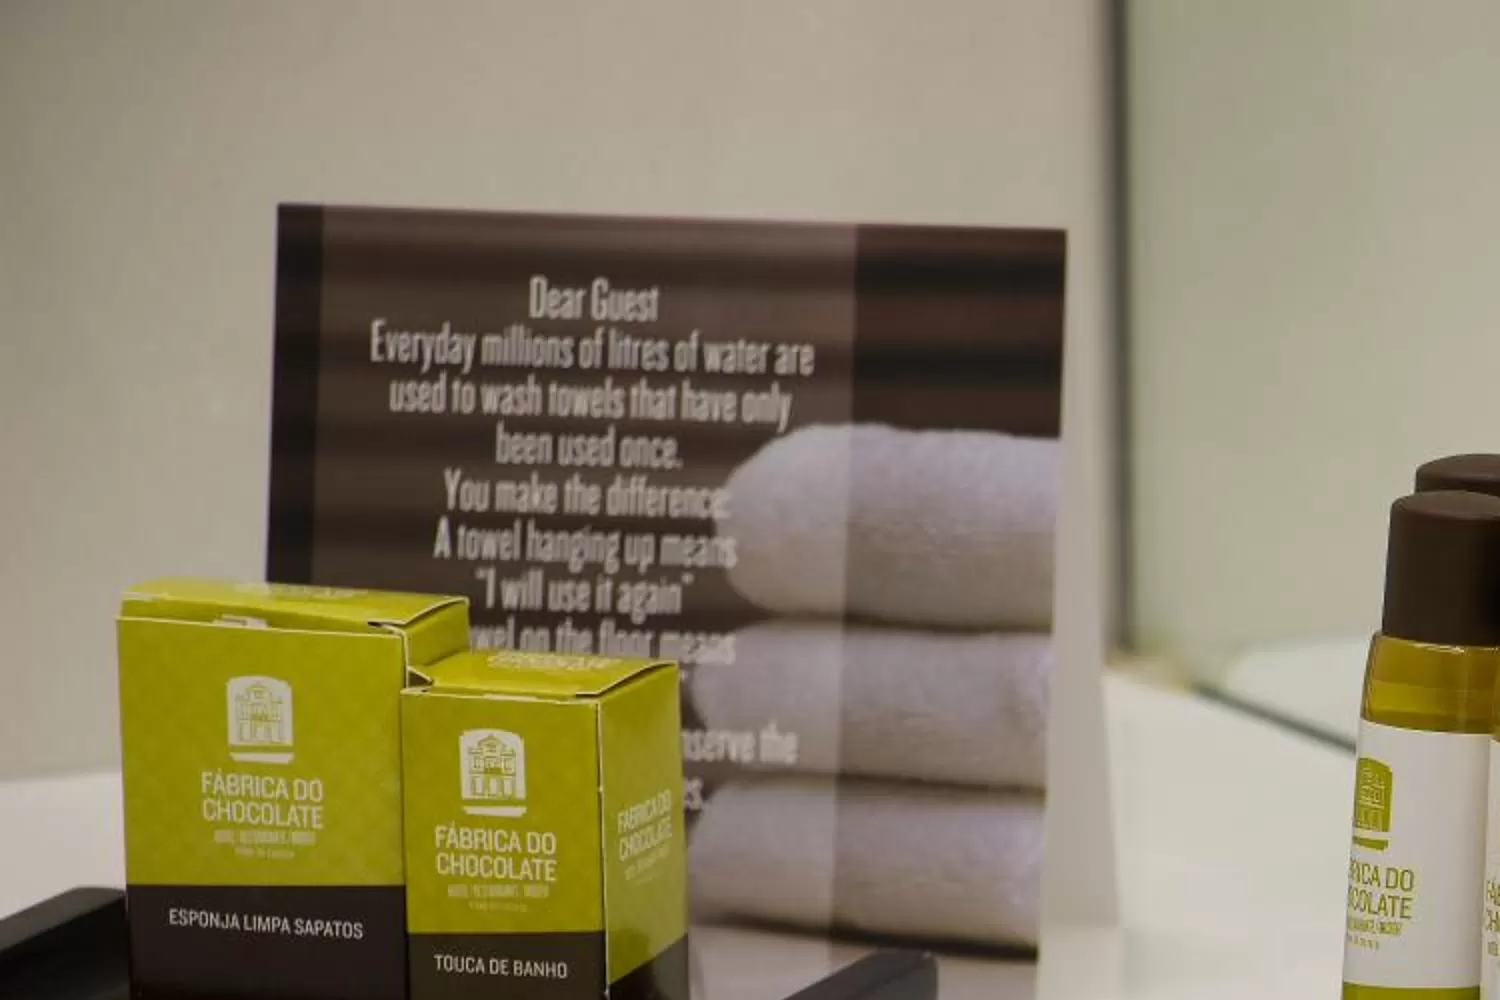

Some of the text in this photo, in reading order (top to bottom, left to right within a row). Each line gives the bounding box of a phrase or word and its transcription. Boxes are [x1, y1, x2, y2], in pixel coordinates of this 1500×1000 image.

[529, 273, 659, 323] Dear Guest
[370, 317, 815, 376] Everyday millions of litres of water are
[389, 370, 794, 434] used to wash towels that have only
[495, 420, 684, 470] been used once.
[443, 468, 490, 513] You
[495, 470, 558, 515] make
[562, 472, 602, 516] the
[432, 516, 738, 574] A towel hanging up means
[500, 568, 544, 612] will
[547, 580, 592, 613] use
[594, 574, 613, 613] it
[470, 614, 516, 651] wel
[519, 626, 550, 653] on
[555, 616, 594, 656] the
[598, 617, 656, 658] floor
[682, 718, 799, 765] serve the
[201, 767, 324, 802] FÁBRICA DO
[203, 798, 325, 829] CHOCOLATE
[435, 819, 558, 856] FÁBRICA DO
[619, 815, 673, 862] CHOCOLATE
[436, 852, 558, 882] CHOCOLATE
[1385, 866, 1415, 892] DO
[169, 908, 364, 941] ESPONJA LIMPA SAPATOS
[433, 954, 568, 979] TOUCA DE BANHO
